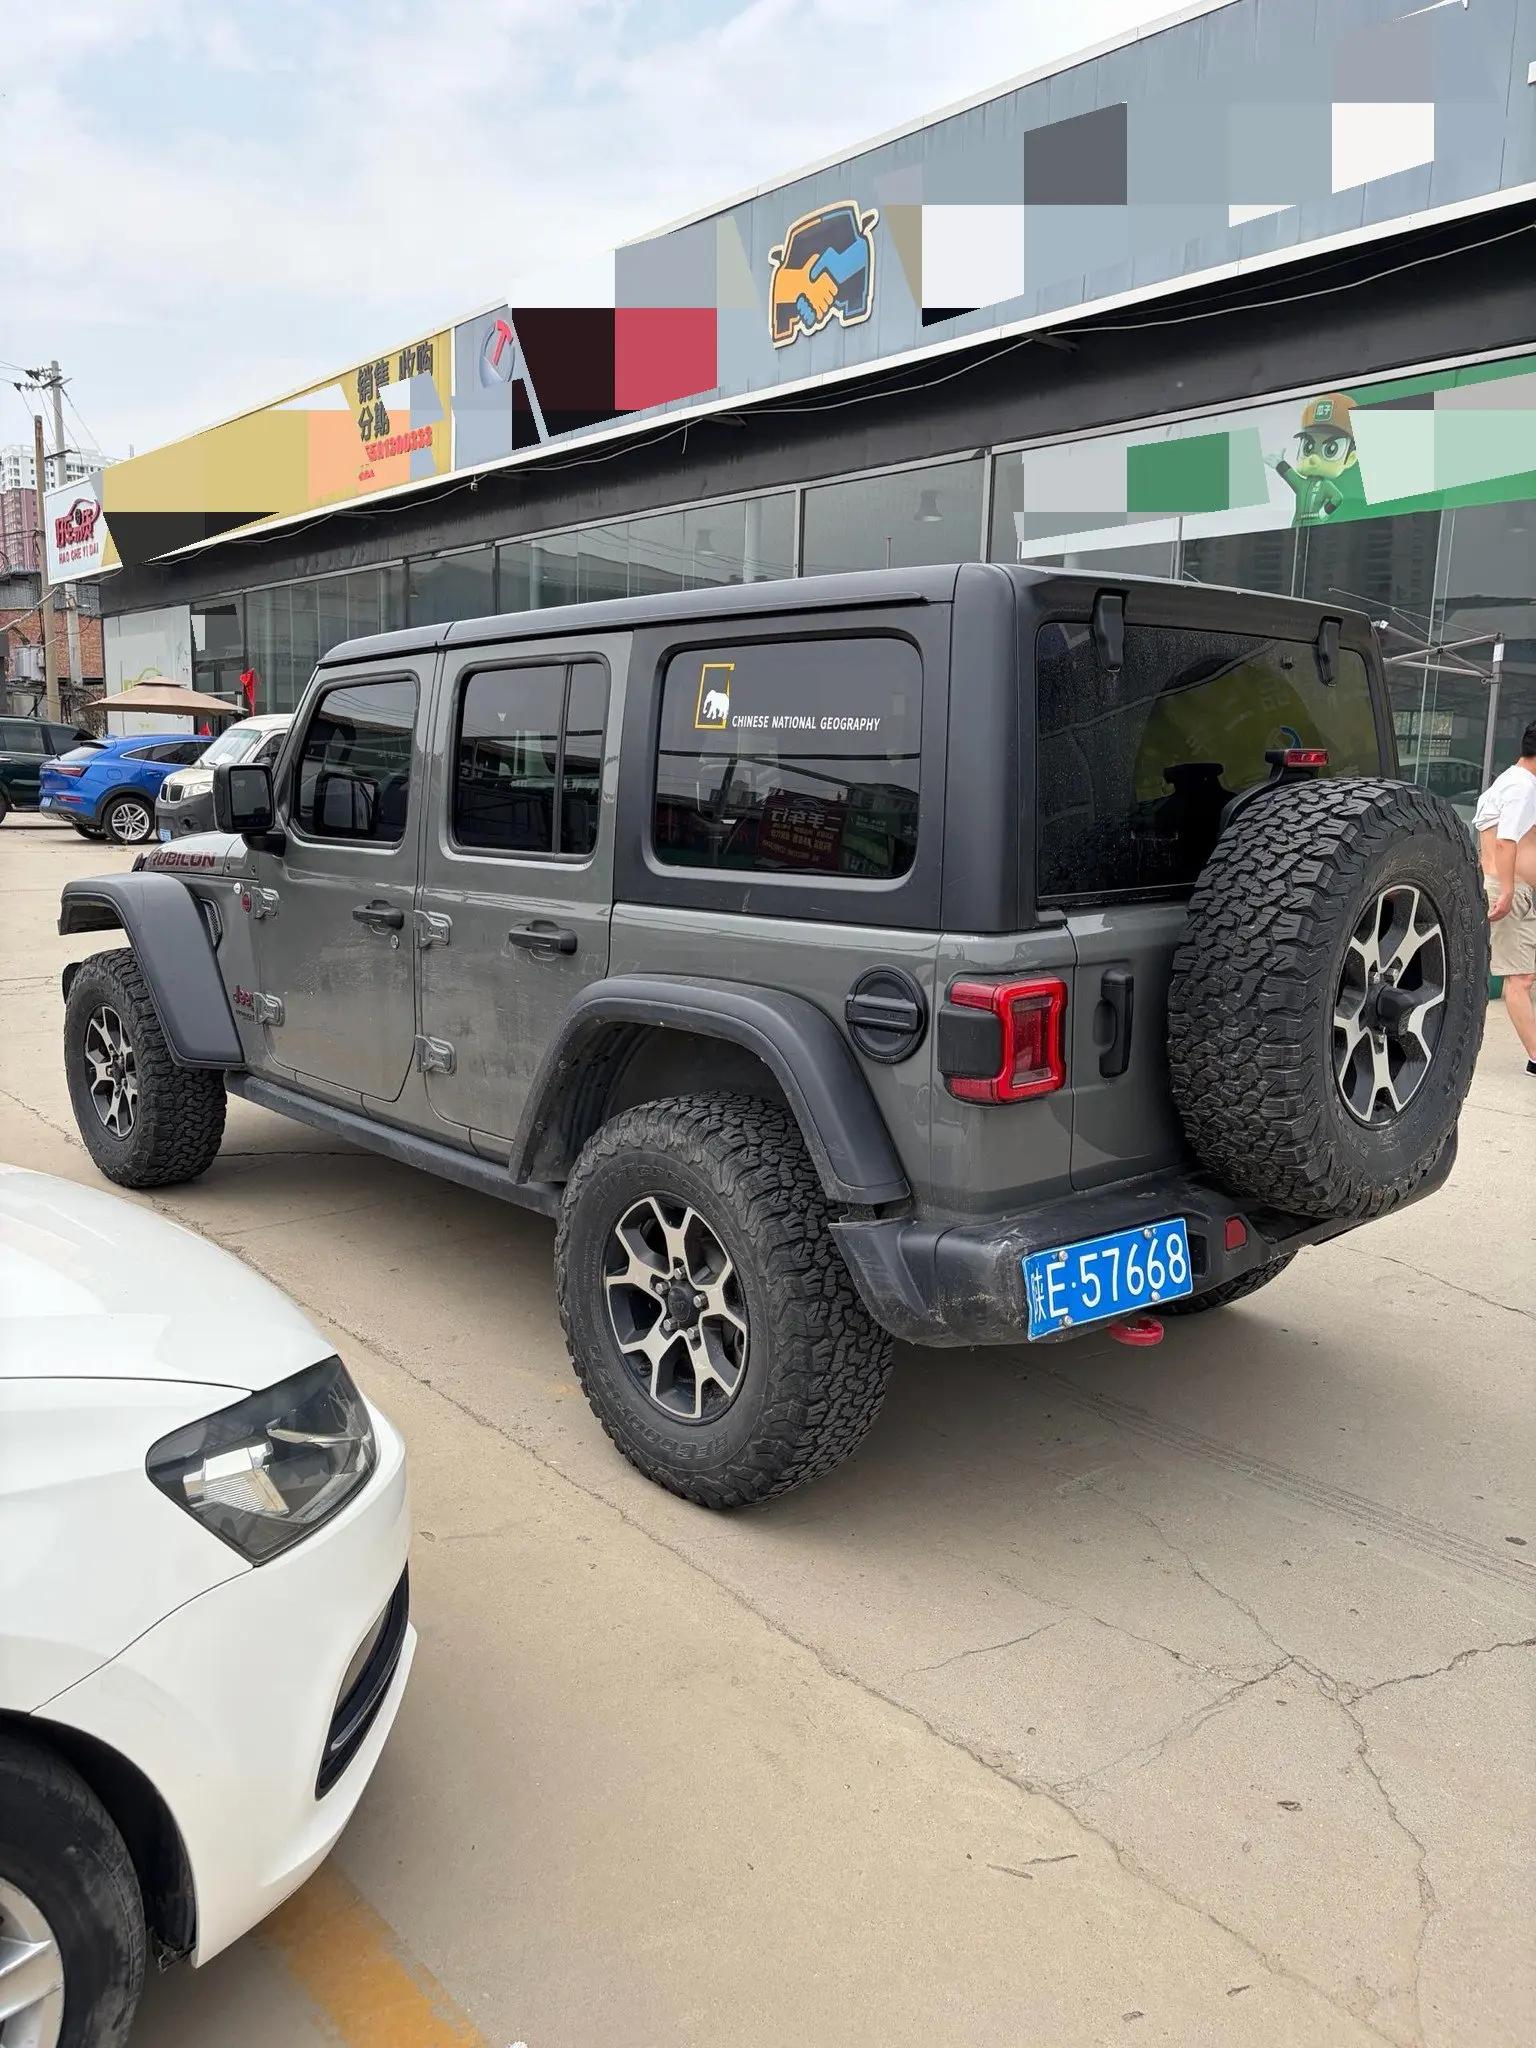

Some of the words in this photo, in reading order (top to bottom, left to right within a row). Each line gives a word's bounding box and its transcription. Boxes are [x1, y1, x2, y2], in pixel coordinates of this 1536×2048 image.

[731, 715, 769, 728] CHINESE
[772, 715, 817, 730] NATIONAL
[820, 716, 880, 731] GEOGRAPHY
[151, 852, 216, 868] RUBICON
